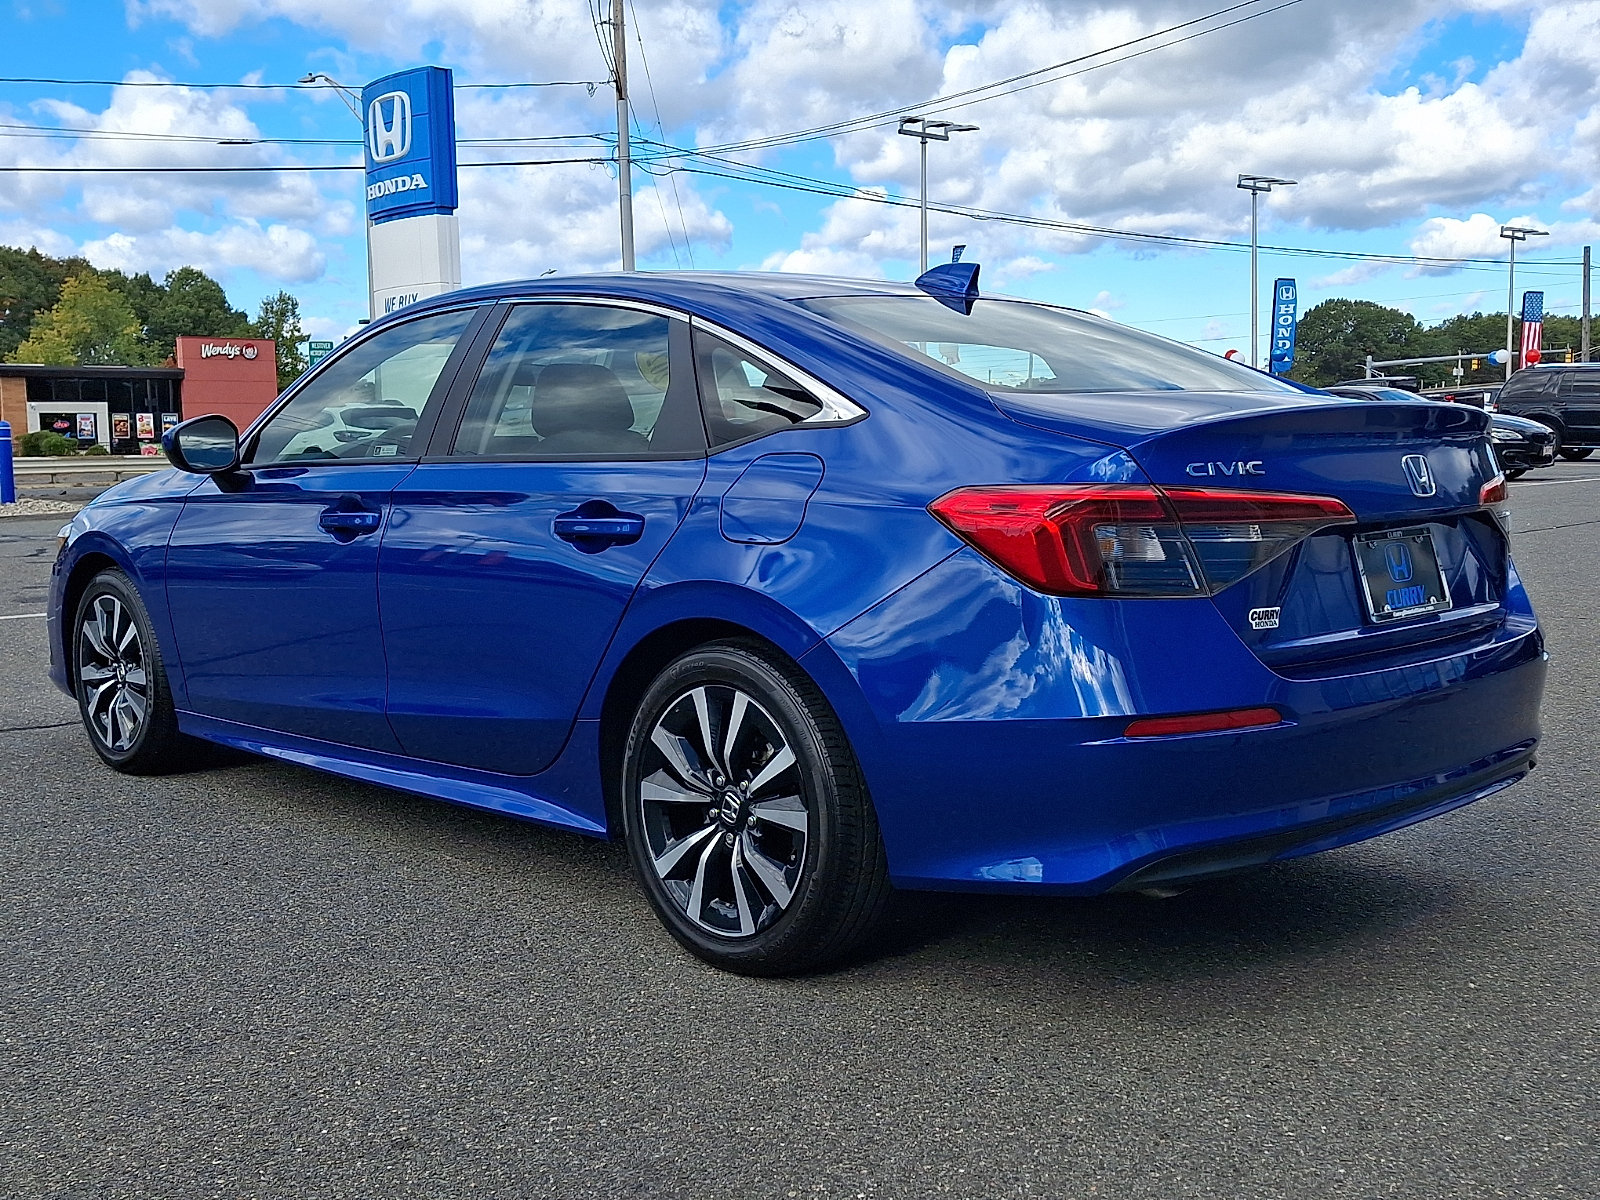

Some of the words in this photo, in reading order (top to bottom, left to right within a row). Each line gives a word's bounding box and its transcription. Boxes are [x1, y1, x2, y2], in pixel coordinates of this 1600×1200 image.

[367, 173, 428, 200] HONDA
[384, 297, 396, 313] WE
[201, 342, 240, 358] Wendy's
[1186, 461, 1265, 476] CIVIC
[1386, 585, 1425, 609] CURRY
[1251, 609, 1279, 621] CURRY
[1254, 620, 1278, 628] HONDA
